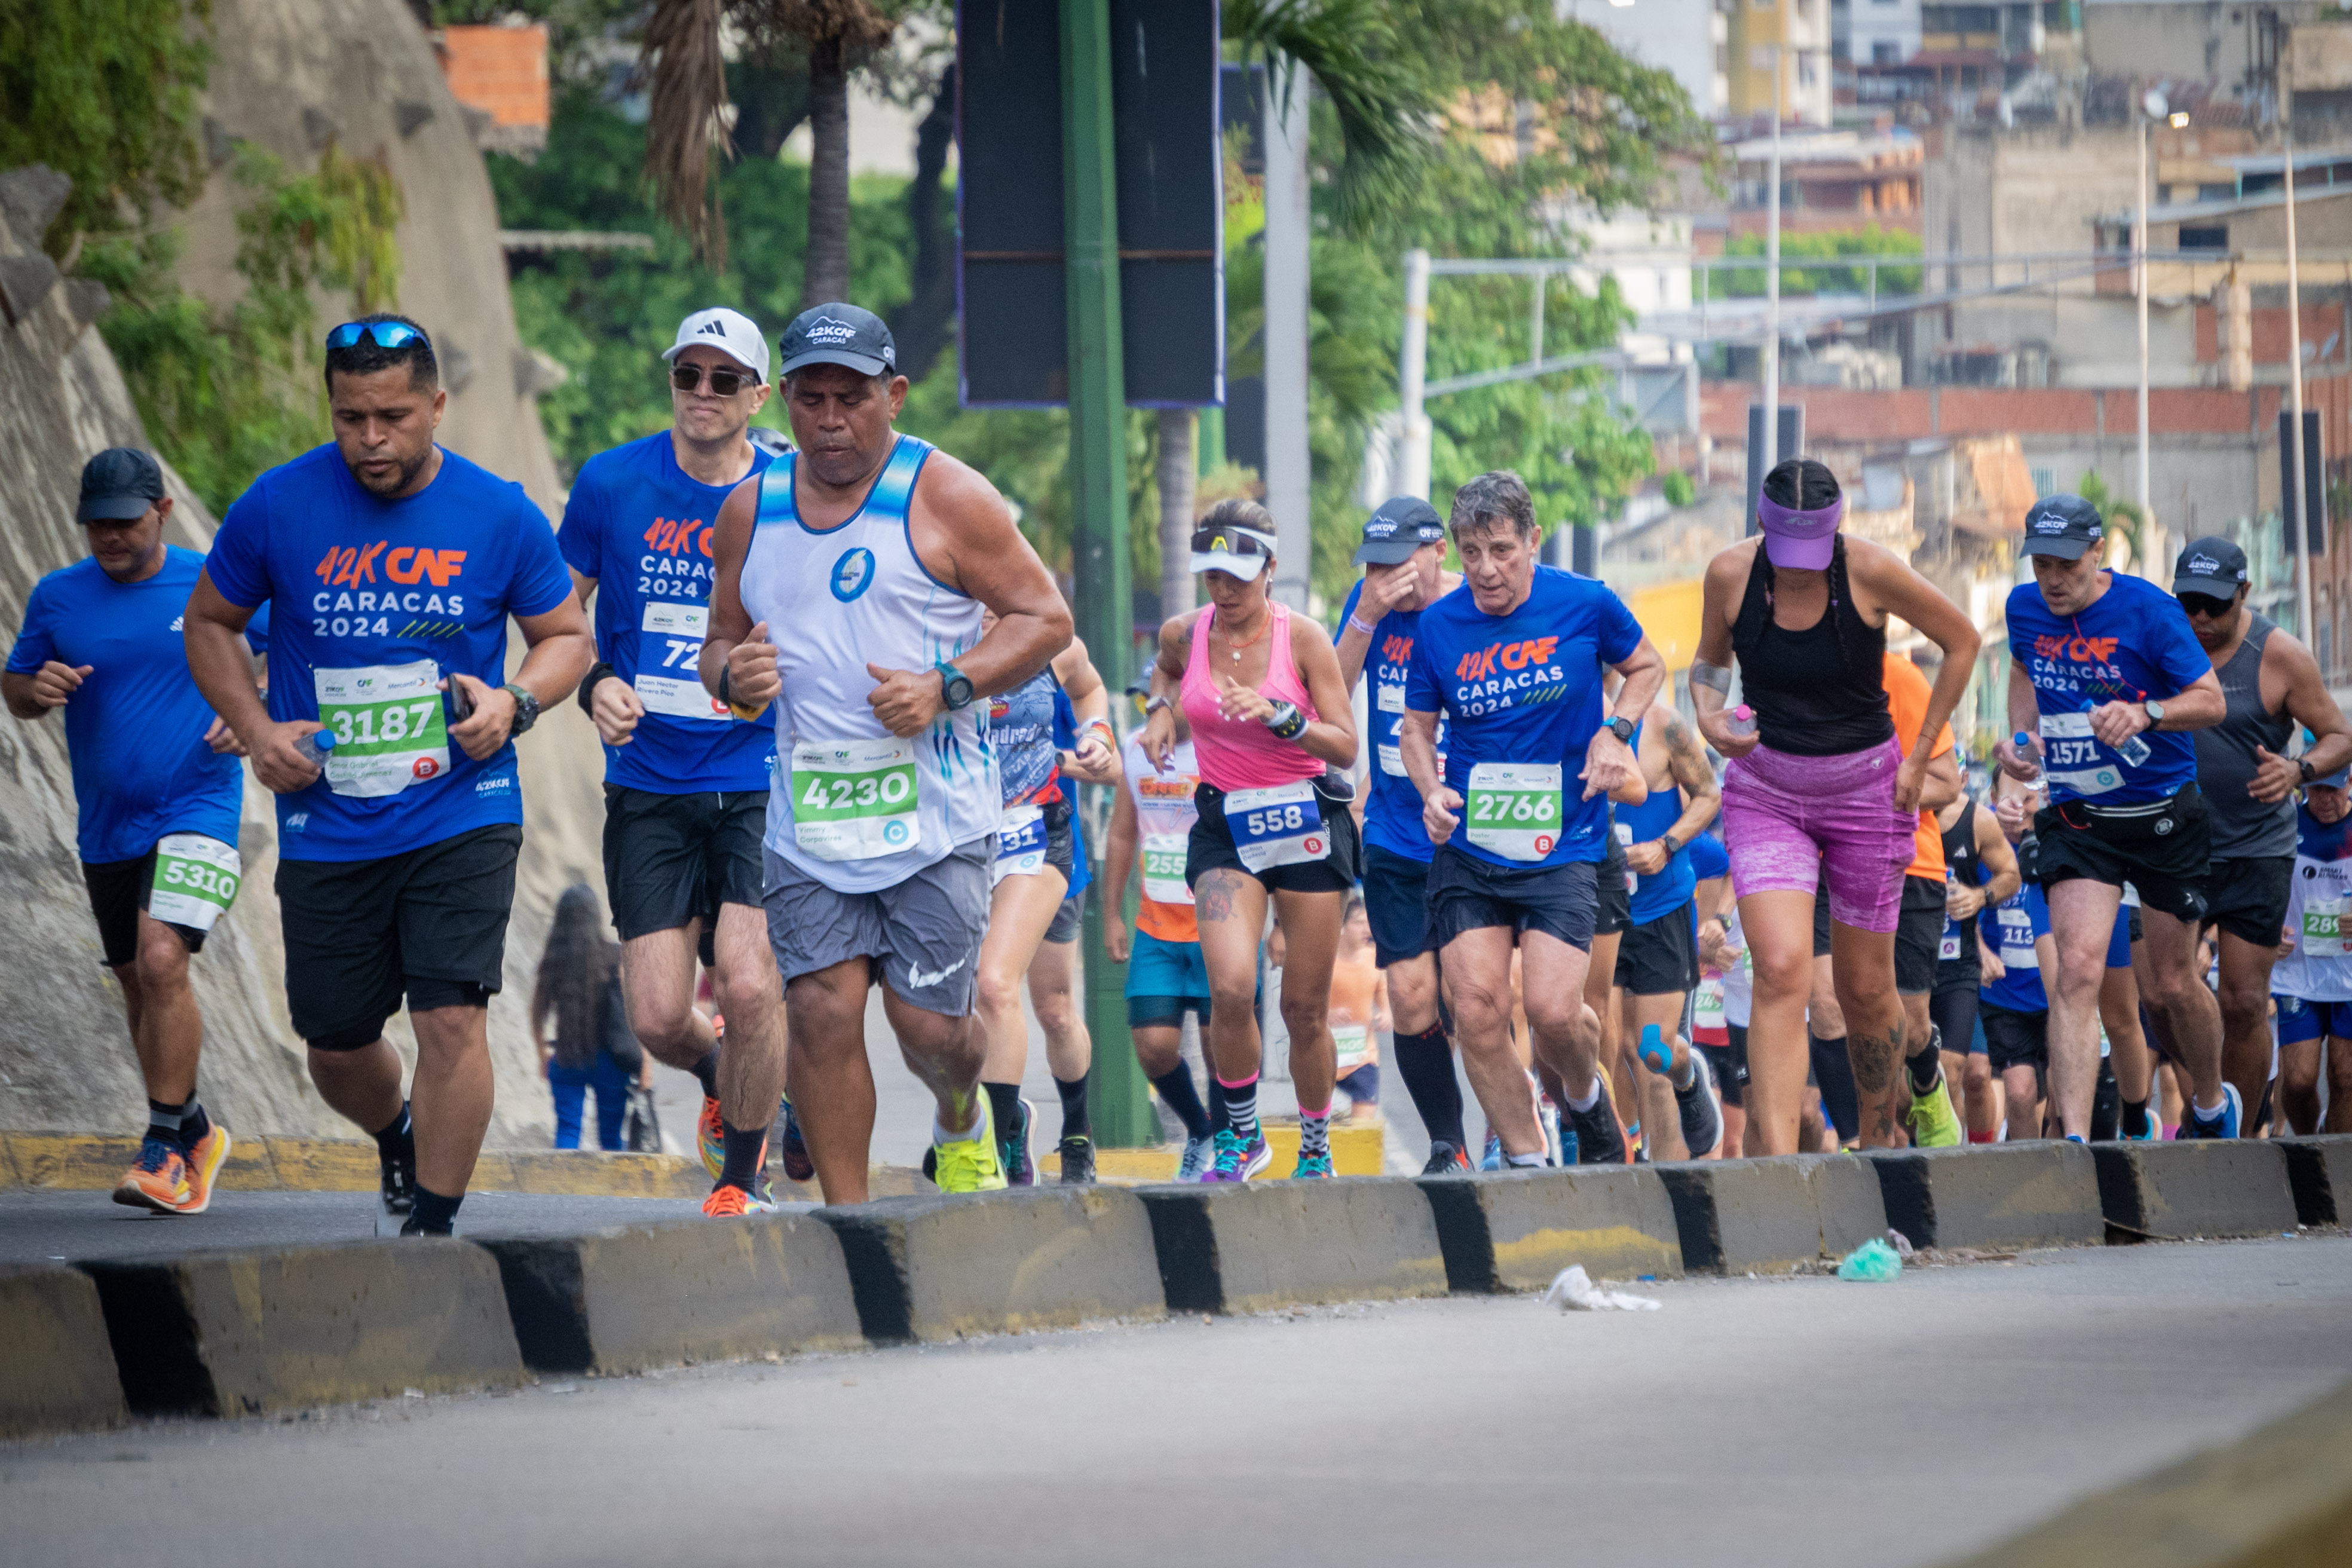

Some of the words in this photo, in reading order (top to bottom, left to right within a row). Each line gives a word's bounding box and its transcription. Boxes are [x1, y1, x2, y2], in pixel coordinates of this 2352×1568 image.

[643, 517, 703, 557] 42K
[315, 540, 388, 590] 42K
[385, 546, 467, 587] CAF
[638, 576, 698, 598] 2024
[313, 591, 464, 616] CARACAS
[313, 617, 390, 638] 2024
[1456, 642, 1501, 681] 42K
[1500, 635, 1560, 670] CAF
[2069, 636, 2119, 662] CAF
[2034, 659, 2121, 679] CARACAS
[388, 680, 417, 690] Mercantil
[1457, 665, 1564, 701] CARACAS
[2034, 674, 2079, 691] 2024
[1460, 695, 1513, 717] 2024
[332, 702, 436, 745] 3187
[2051, 740, 2101, 764] 1571
[419, 762, 433, 775] B
[803, 771, 910, 810] 4230
[1474, 794, 1555, 821] 2766
[889, 825, 904, 840] C
[1248, 806, 1303, 835] 558
[998, 826, 1039, 852] 31
[1308, 840, 1319, 852] B
[1539, 838, 1549, 850] B
[1147, 854, 1187, 875] 255
[164, 860, 235, 899] 5310
[1695, 994, 1721, 1009] 24
